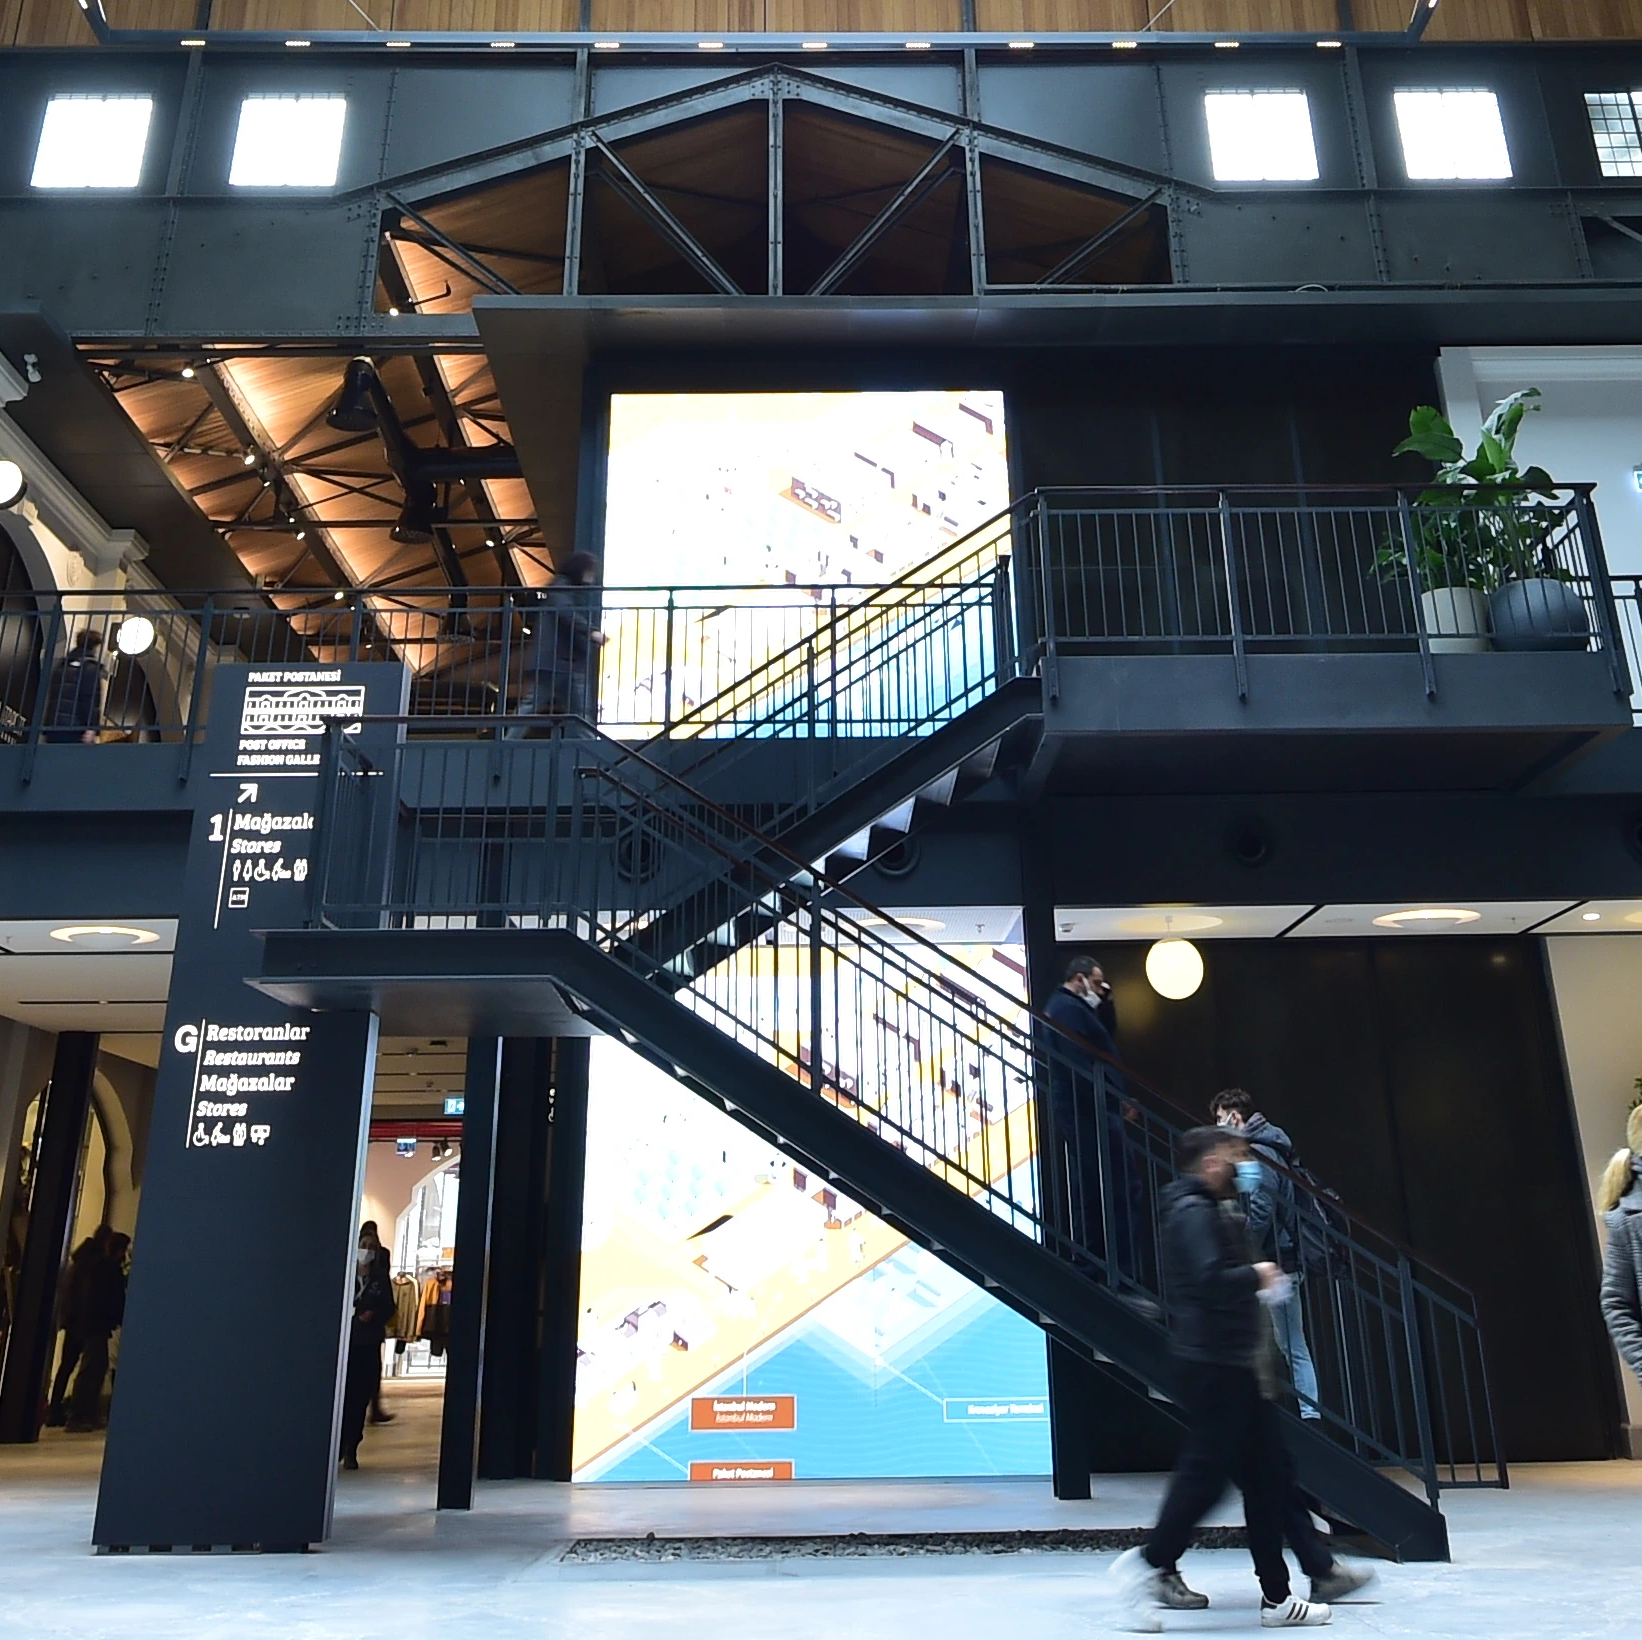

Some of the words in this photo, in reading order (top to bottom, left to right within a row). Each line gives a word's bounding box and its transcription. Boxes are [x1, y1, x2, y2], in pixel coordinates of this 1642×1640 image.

[248, 672, 283, 682] PAKET
[283, 669, 341, 682] POSTANESİ
[239, 739, 267, 750] POST
[268, 739, 306, 750] OFFICE
[237, 755, 285, 765] FASHION
[286, 754, 320, 765] GALLE
[209, 814, 223, 841] 1
[234, 812, 314, 834] Mağazal
[231, 839, 281, 853] Stores
[174, 1025, 198, 1052] G
[206, 1023, 310, 1041] Restoranlar
[203, 1050, 301, 1065] Restaurants
[199, 1073, 295, 1096] Mağazalar
[196, 1101, 248, 1116] Stores
